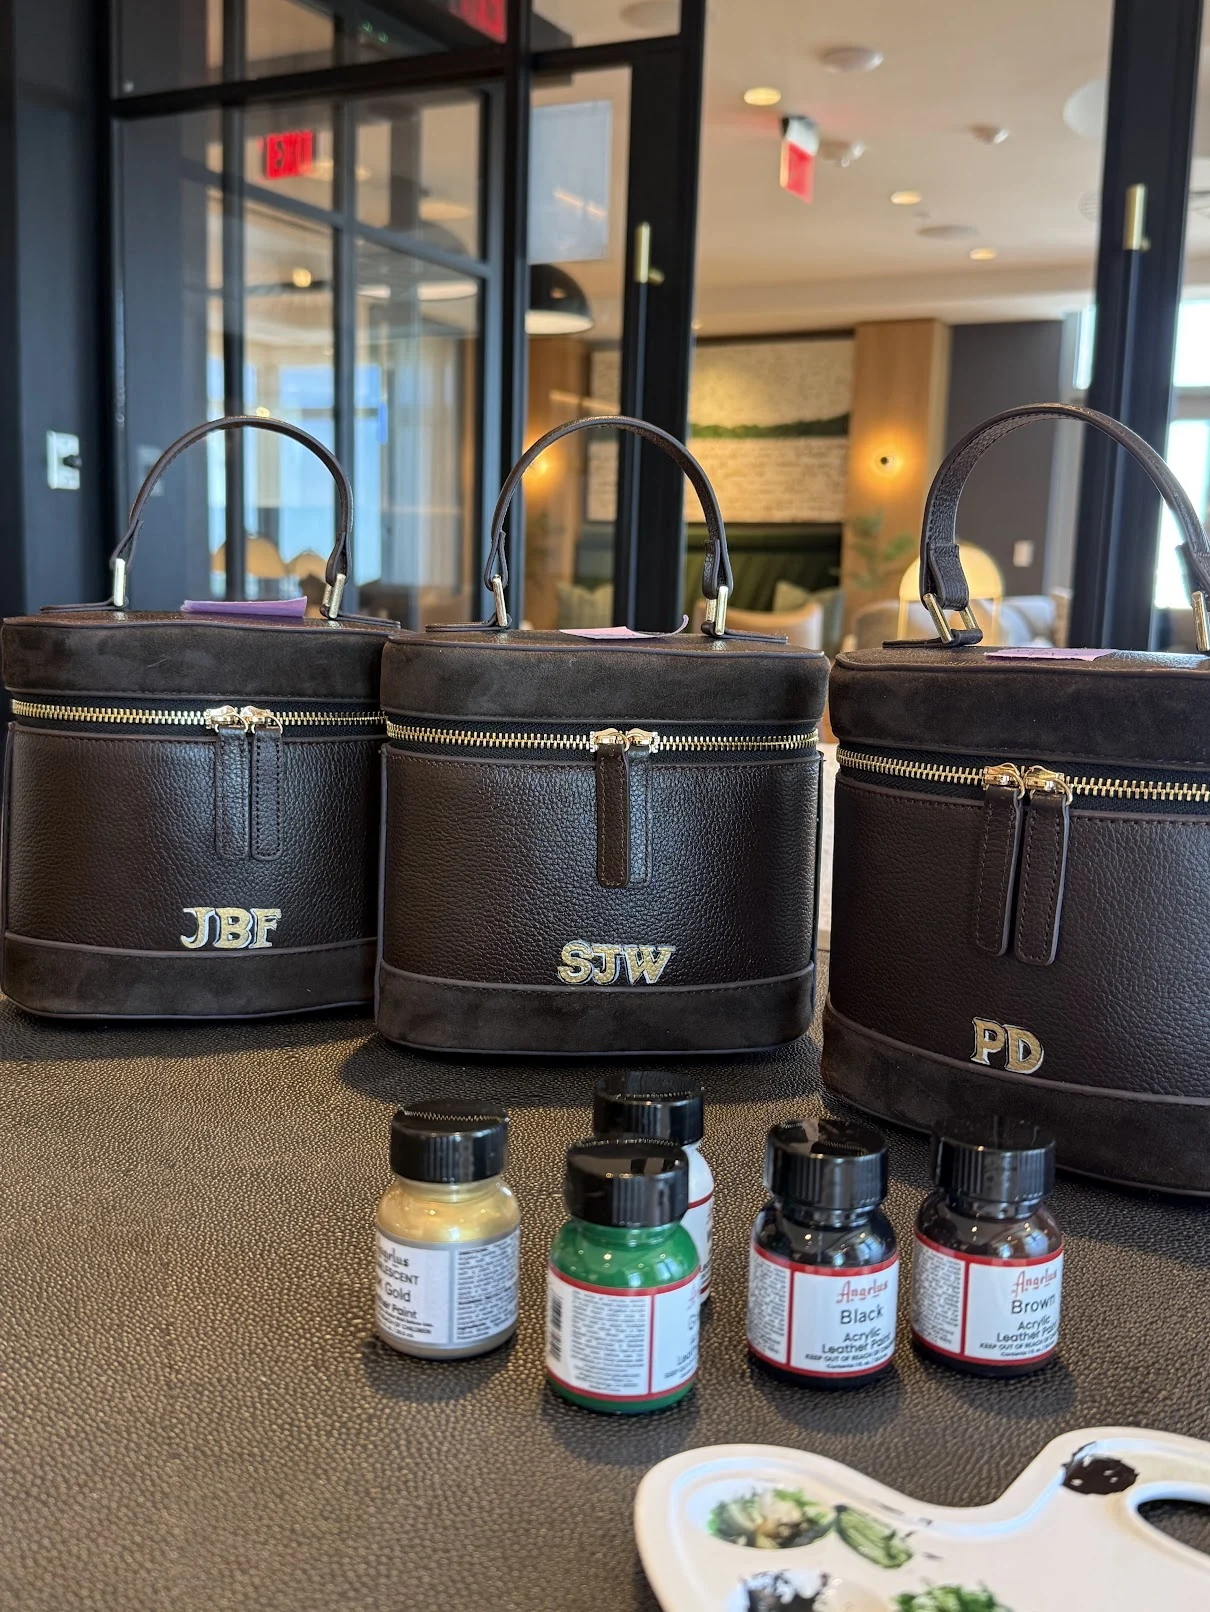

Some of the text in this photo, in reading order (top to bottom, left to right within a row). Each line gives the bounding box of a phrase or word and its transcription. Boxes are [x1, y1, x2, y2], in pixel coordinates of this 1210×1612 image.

[266, 129, 314, 180] EXIT
[180, 906, 282, 949] JBF
[557, 940, 676, 986] SJW
[970, 1016, 1045, 1075] PD
[385, 1281, 411, 1303] Gold
[835, 1278, 889, 1305] Angelus
[392, 1303, 418, 1320] Paint
[840, 1304, 885, 1326] Black
[1011, 1293, 1056, 1315] Brown
[843, 1326, 882, 1343] Acrylic
[996, 1330, 1040, 1343] Leather
[821, 1343, 869, 1355] Leather
